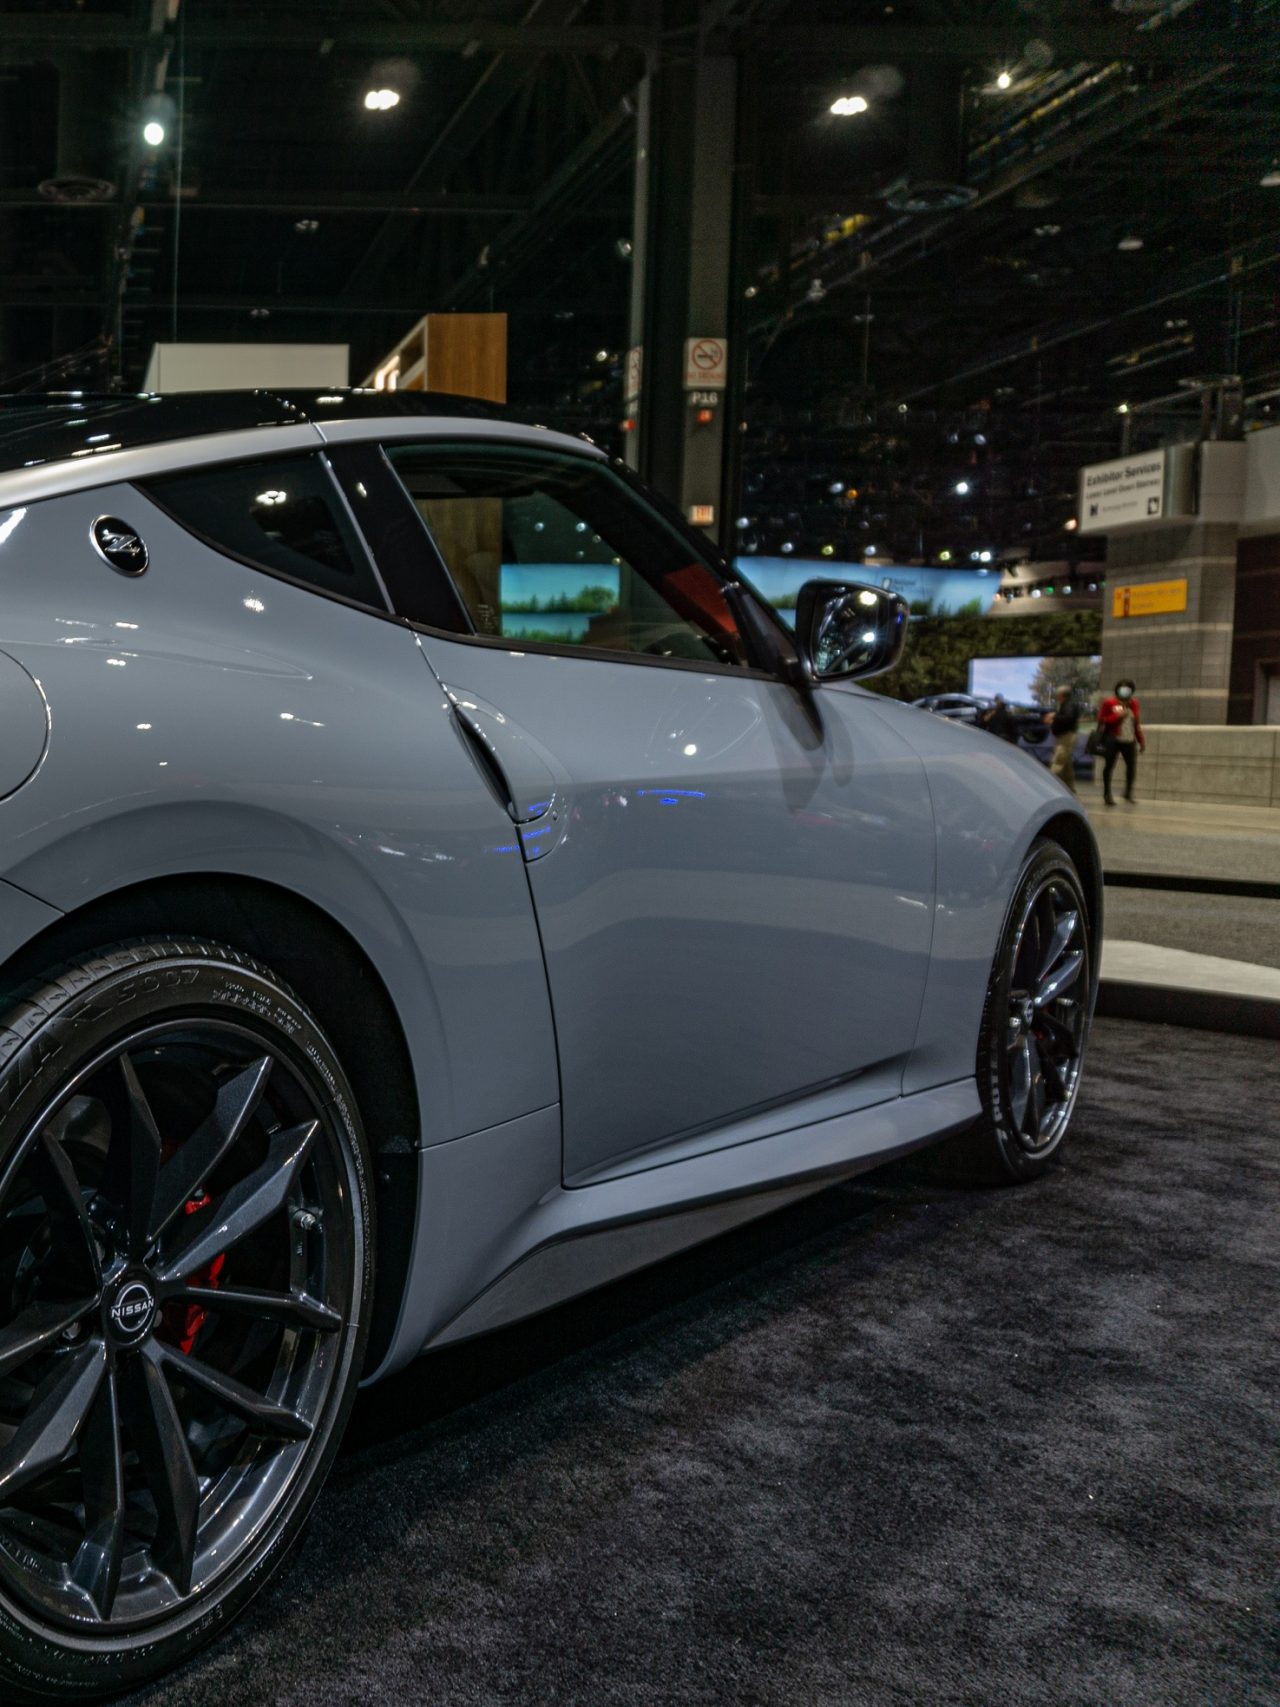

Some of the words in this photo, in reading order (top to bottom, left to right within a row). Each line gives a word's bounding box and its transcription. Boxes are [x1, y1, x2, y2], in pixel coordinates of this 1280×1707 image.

[692, 392, 718, 404] P16
[1086, 472, 1122, 487] Exhibitor
[1124, 462, 1161, 478] Services
[111, 1297, 154, 1319] NISSAN
